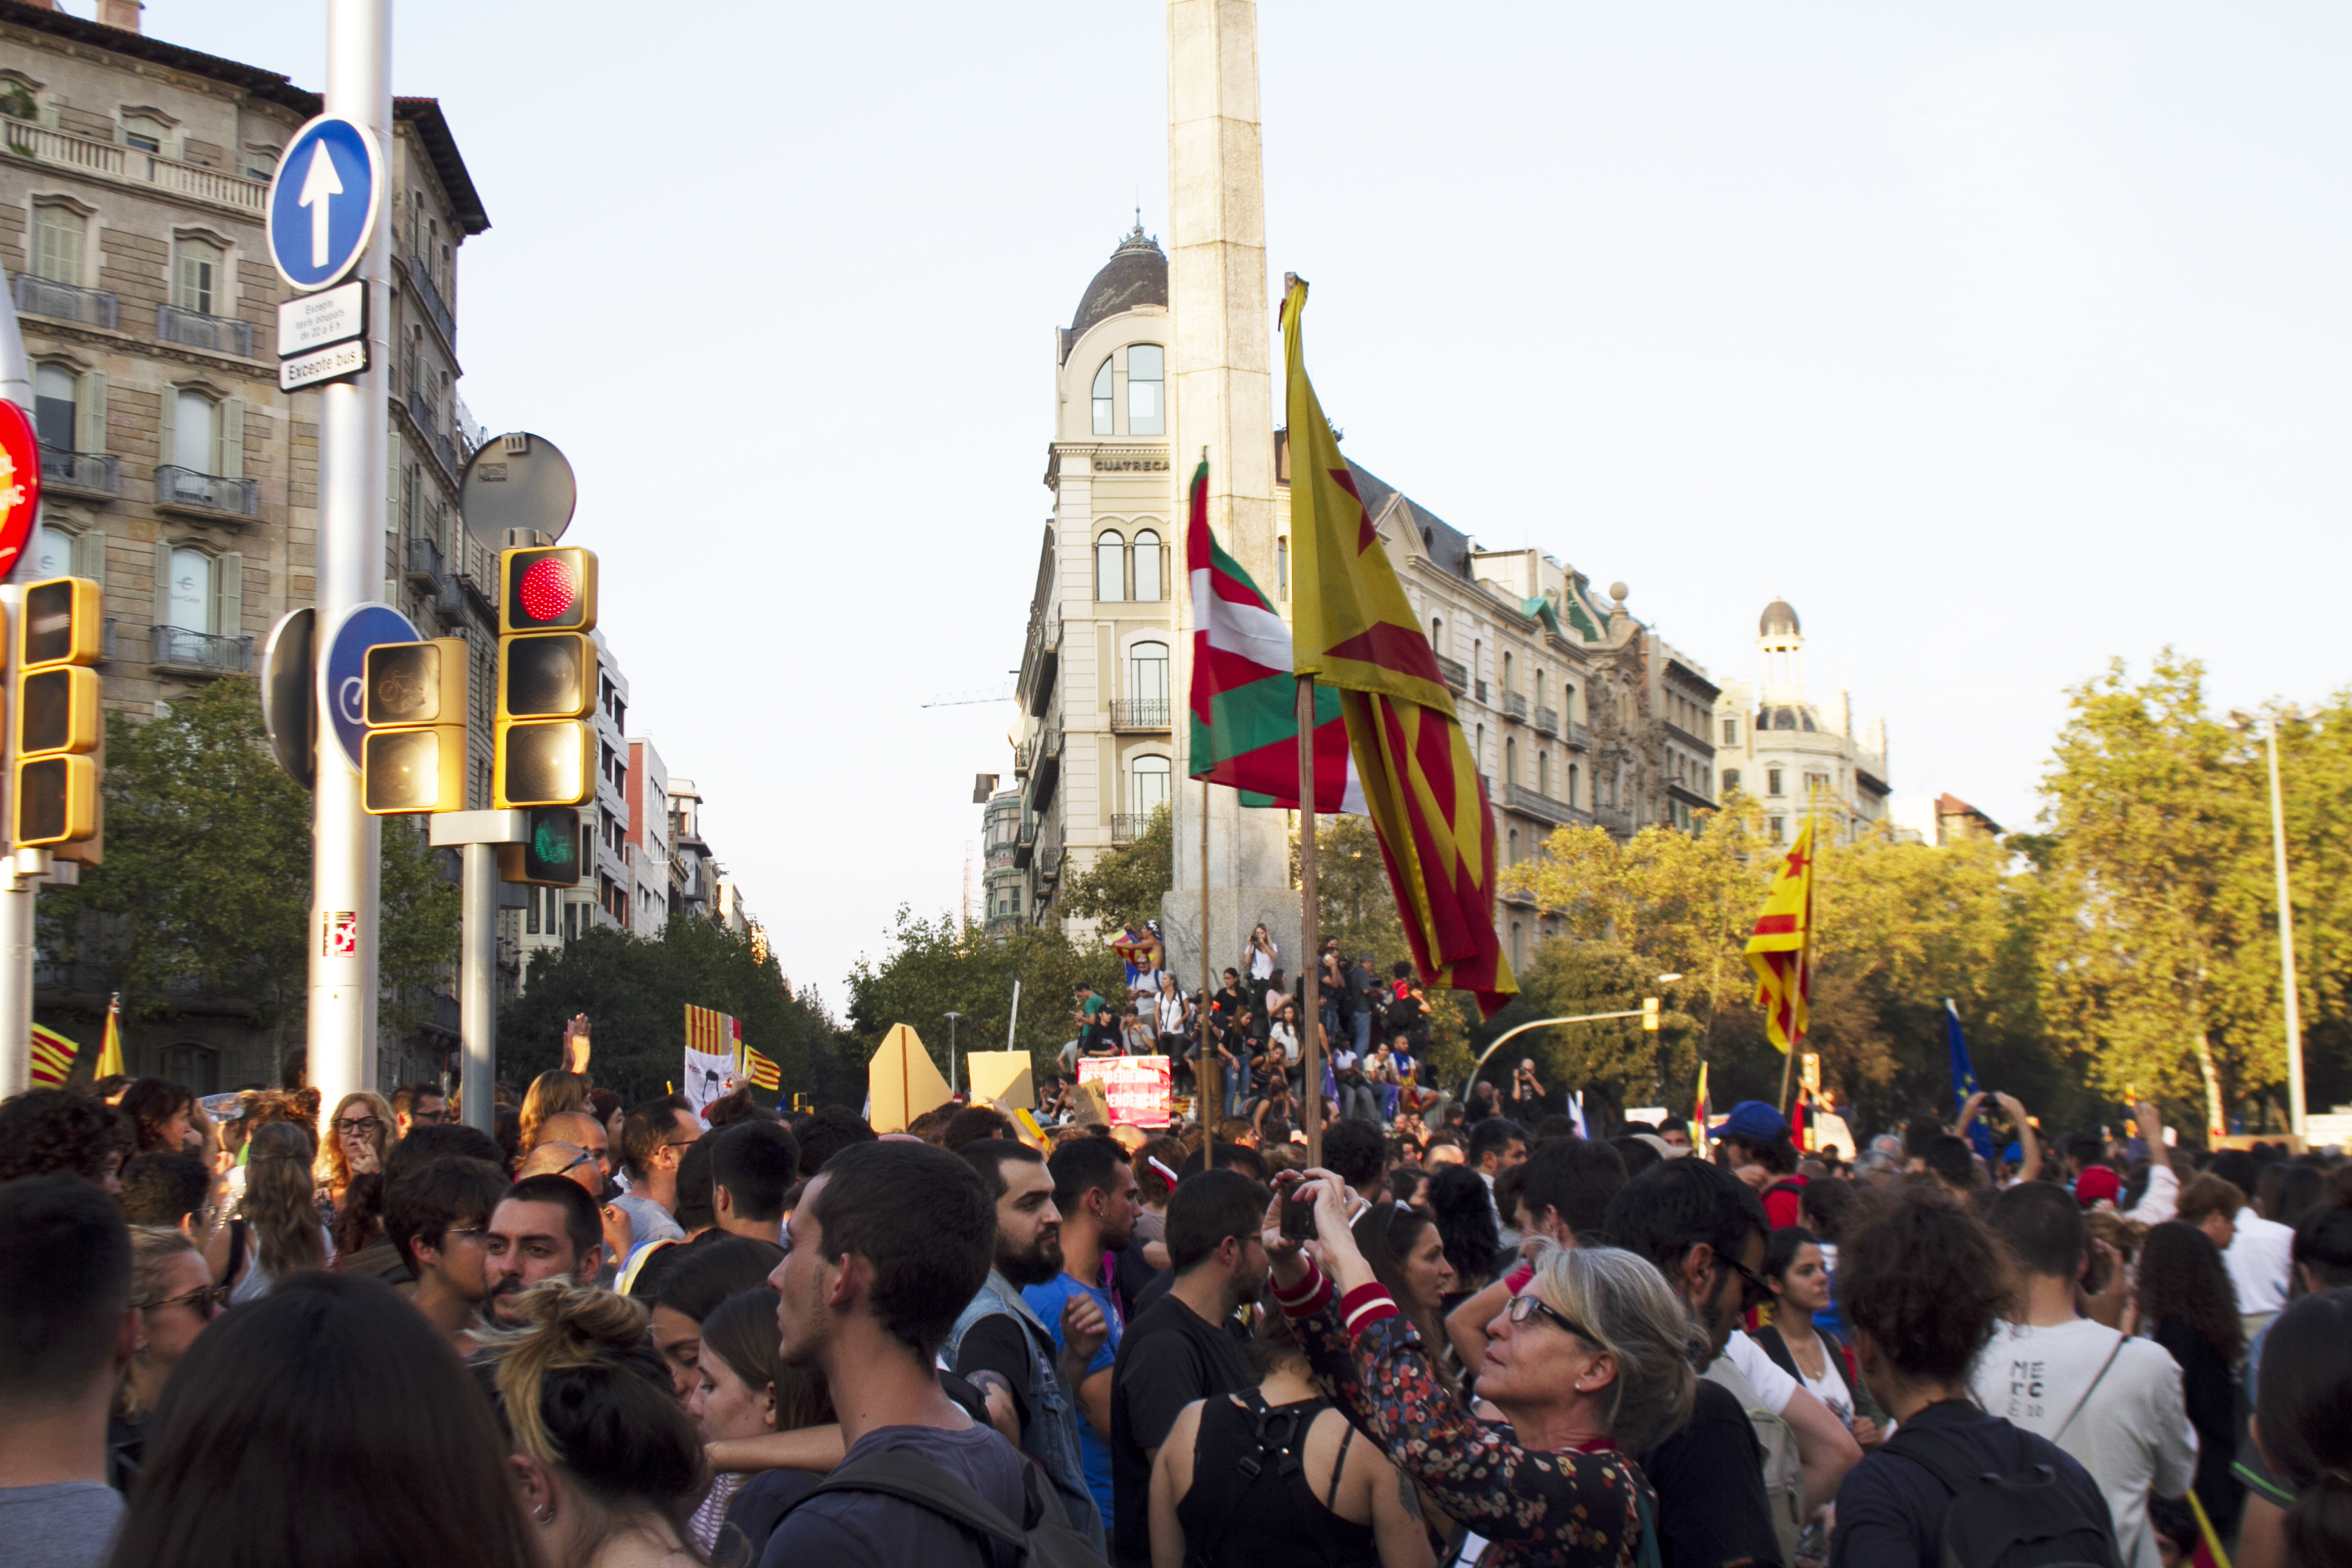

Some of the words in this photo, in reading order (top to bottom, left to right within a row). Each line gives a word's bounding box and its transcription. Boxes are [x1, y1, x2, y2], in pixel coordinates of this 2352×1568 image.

[306, 301, 334, 313] Excepte
[296, 319, 313, 330] taxis
[301, 331, 310, 341] de
[289, 358, 333, 380] Excepte
[337, 351, 356, 366] bus
[1094, 460, 1170, 471] CUATRECA
